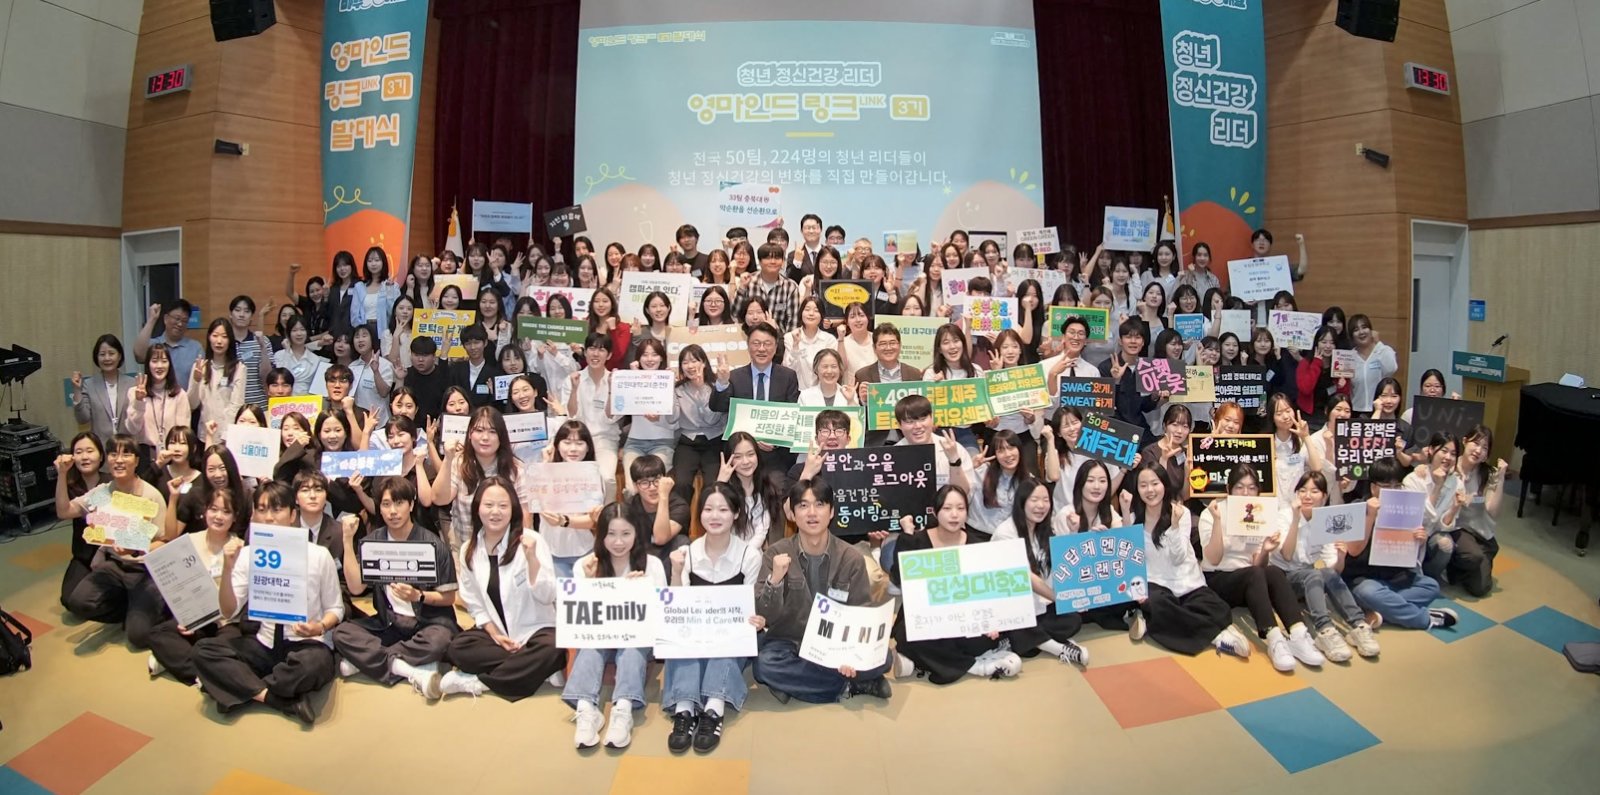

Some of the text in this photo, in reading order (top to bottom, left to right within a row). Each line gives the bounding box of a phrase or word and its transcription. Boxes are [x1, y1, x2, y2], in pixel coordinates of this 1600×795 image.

[332, 34, 410, 70] 영마인드
[1176, 40, 1211, 68] 청년
[740, 66, 874, 84] 청년 정신건강 리더
[1176, 76, 1248, 108] 정신건강
[688, 94, 799, 123] 영마인드
[897, 99, 924, 117] 3기
[331, 115, 399, 150] 발대식
[1214, 117, 1249, 144] 리더
[694, 148, 926, 166] 전국 50팀, 224명의 청년 리더들이
[668, 171, 697, 186] 청년
[778, 169, 822, 185] 변화를
[827, 169, 855, 185] 직접
[860, 169, 952, 186] 만들어갑니다.
[629, 284, 661, 294] 캠퍼스를
[952, 383, 978, 403] 제주
[750, 408, 780, 421] 마음의
[755, 422, 785, 436] 진정한
[1363, 422, 1397, 437] 장벽은
[1077, 427, 1138, 466] 제주대
[824, 453, 895, 472] 불안과 우울
[1206, 453, 1226, 463] 아끼는
[1226, 454, 1238, 464] 가장
[1239, 454, 1251, 464] 쉬운
[1337, 448, 1360, 464] 우리
[872, 470, 928, 488] 로그아웃
[833, 488, 880, 503] 음건강은
[838, 505, 901, 524] 동아링으로
[182, 554, 197, 569] 39
[254, 548, 282, 569] 39
[1055, 538, 1145, 581] 나답게 멘탈도
[1080, 560, 1125, 581] 브랜딩
[253, 575, 291, 588] 원광대학교
[928, 569, 1030, 605] 연성대학교
[663, 606, 689, 615] Global
[663, 616, 685, 625] 우리의
[817, 618, 886, 644] MIND
